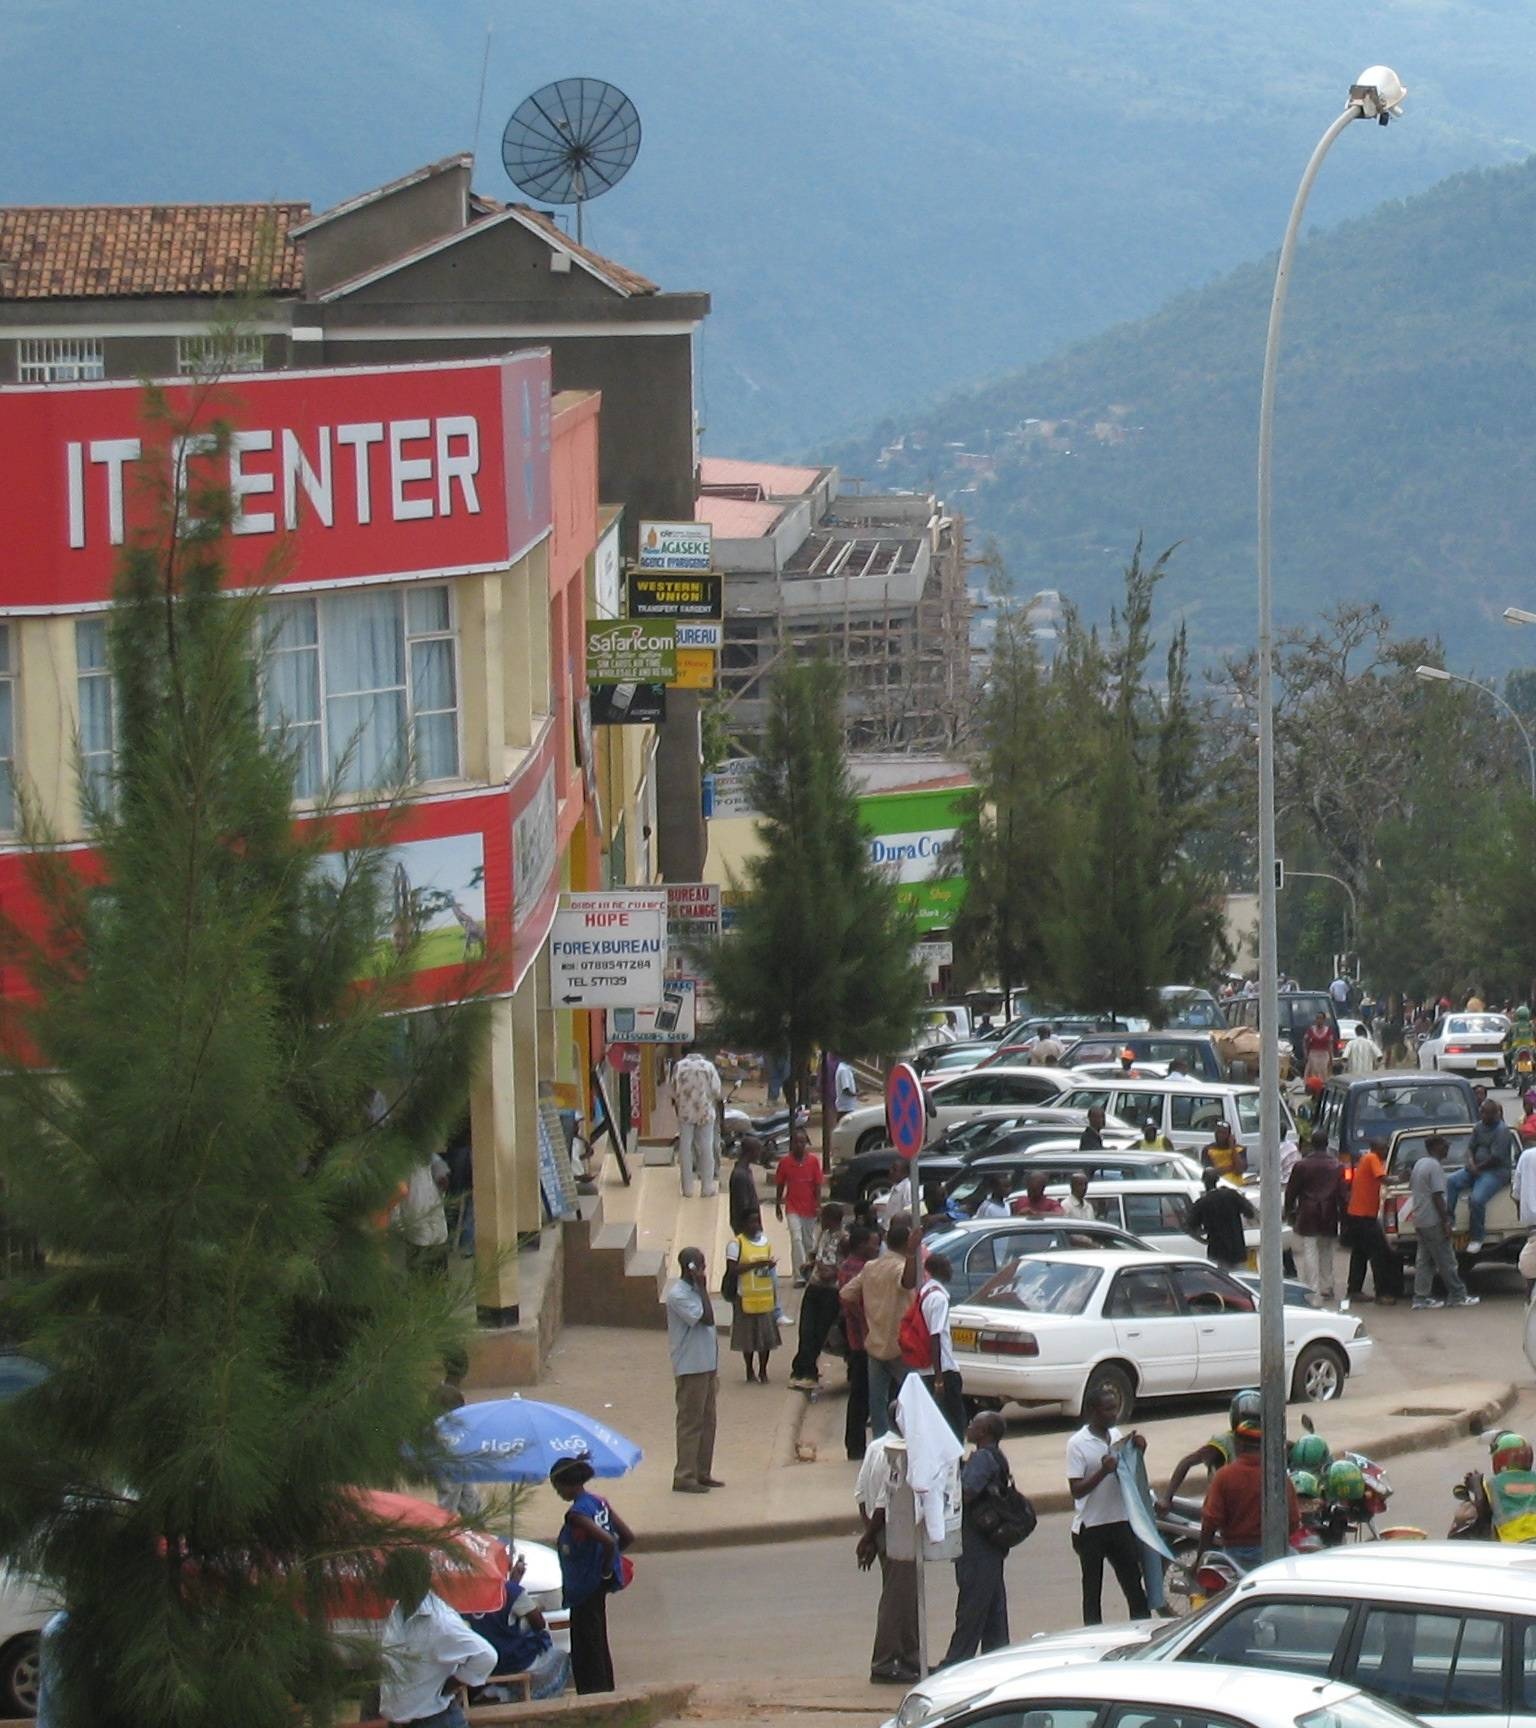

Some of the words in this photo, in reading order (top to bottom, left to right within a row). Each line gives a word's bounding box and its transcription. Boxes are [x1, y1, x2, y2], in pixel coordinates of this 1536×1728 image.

[67, 438, 141, 548] IT
[172, 415, 481, 538] CENTER
[661, 541, 710, 555] AGASEKE
[636, 581, 700, 592] WESTERN
[656, 592, 700, 602] UNION
[589, 629, 674, 652] Safaricom
[676, 629, 717, 644] BUREAU
[872, 836, 942, 864] DuraCo
[668, 887, 710, 901] BUREAU
[679, 904, 718, 918] CHANGE
[585, 912, 630, 928] HOPE
[568, 977, 588, 987] TEL
[481, 1437, 526, 1452] tigo
[550, 1434, 588, 1453] tigo
